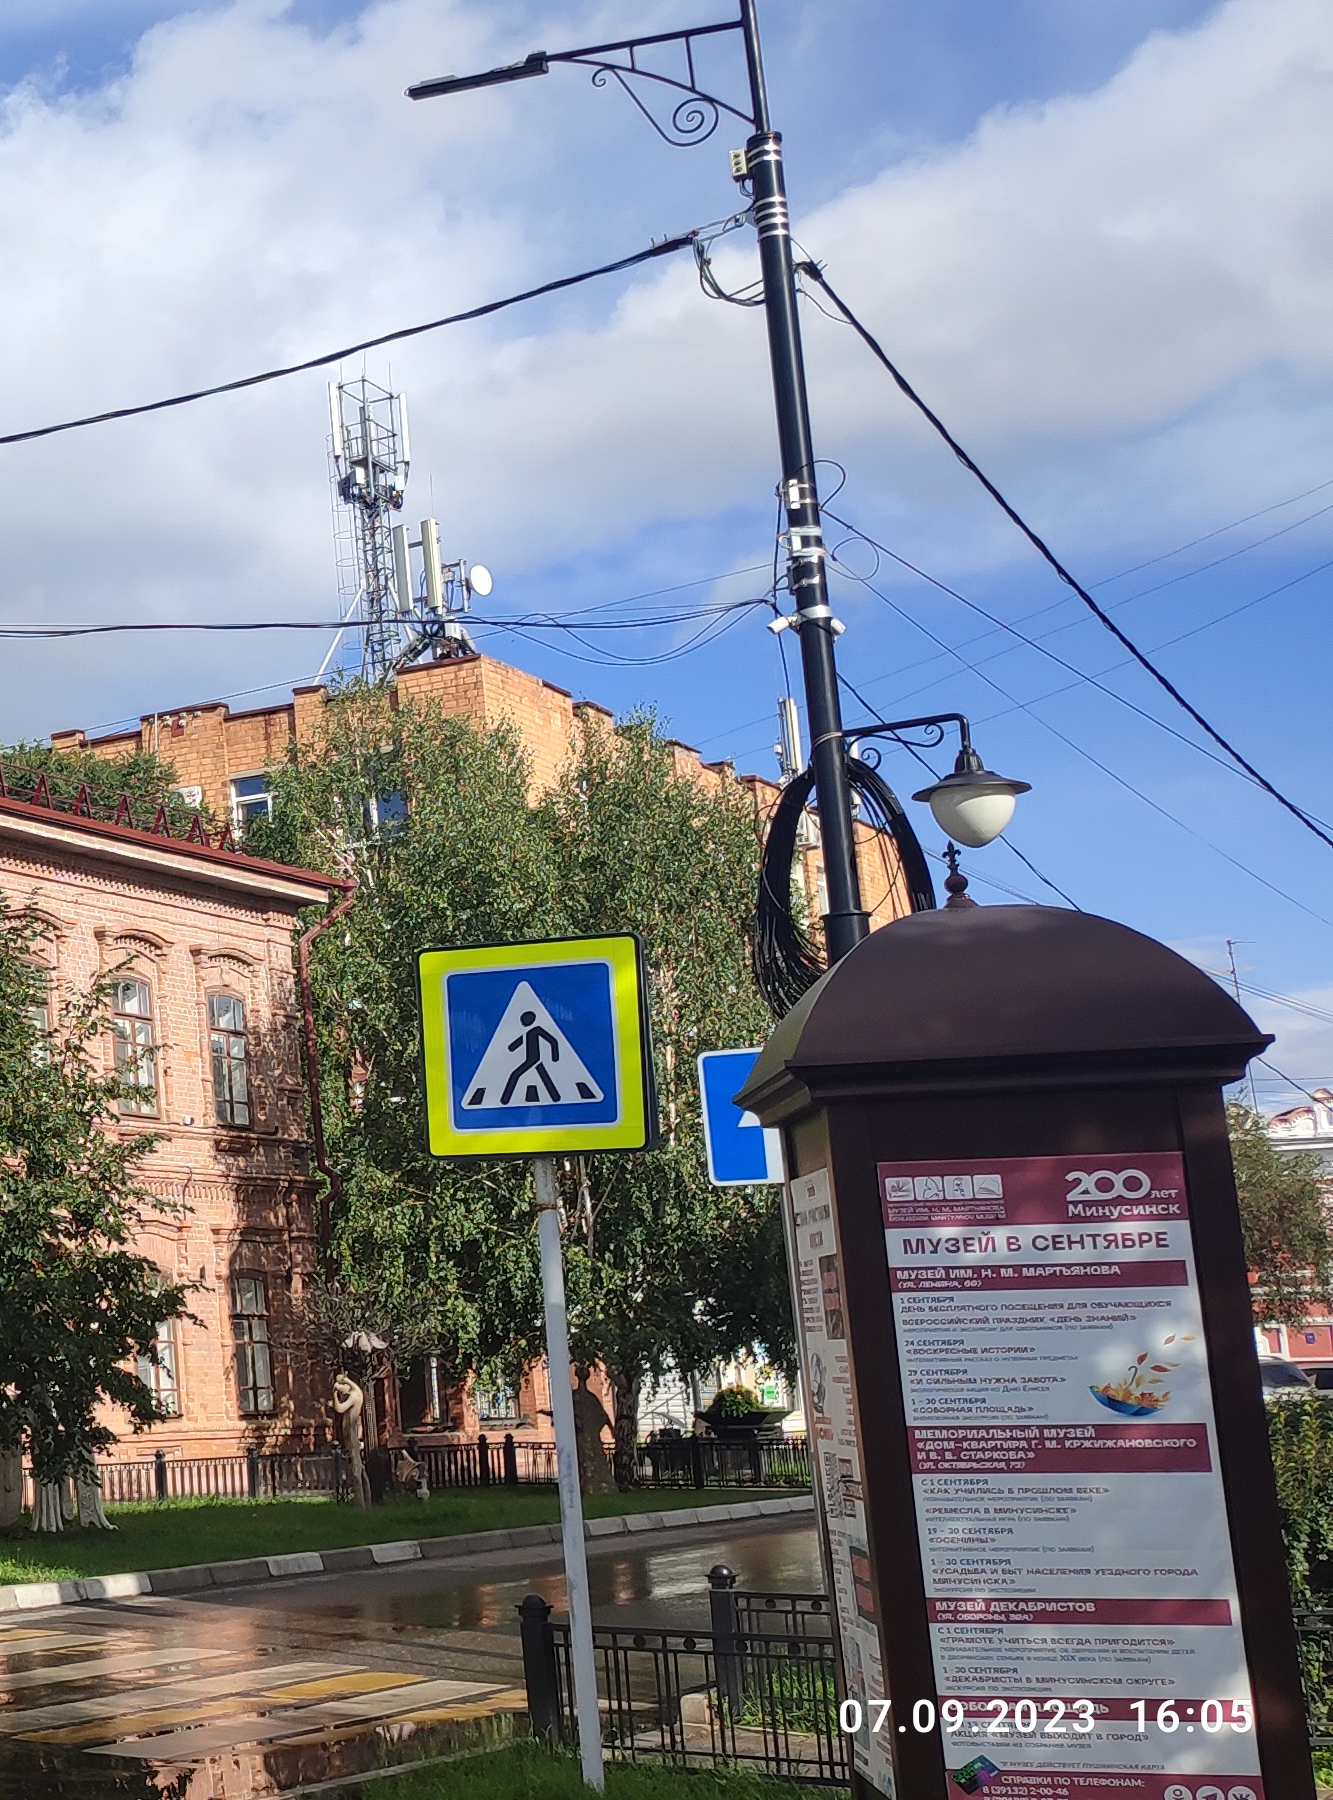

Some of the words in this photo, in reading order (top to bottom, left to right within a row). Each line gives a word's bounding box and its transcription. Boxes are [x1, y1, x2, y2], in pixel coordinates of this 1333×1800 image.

[1064, 1169, 1152, 1201] 200
[1150, 1189, 1179, 1199] лет
[1067, 1203, 1181, 1219] Минусинск
[902, 1230, 997, 1255] МУЗЕЙ
[1005, 1235, 1022, 1253] В
[1031, 1231, 1171, 1252] СЕНТЯБРЕ
[896, 1267, 946, 1280] МУЗЕЙ
[949, 1268, 978, 1279] ИМ.
[999, 1267, 1019, 1278] М.
[1021, 1264, 1122, 1277] МАРТЬЯНОВА
[907, 1296, 955, 1304] СЕНТЯБРЯ
[900, 1305, 926, 1313] ДЕНЬ
[928, 1304, 999, 1312] БЕСПЛАТНОГО
[1066, 1302, 1088, 1310] ДЛЯ
[1090, 1300, 1173, 1309] ОБУЧАЮЩИХСЯ
[902, 1316, 990, 1326] ВСЕРОССИЙСКИЙ
[992, 1315, 1046, 1325] ПРАЗДНИК
[916, 1339, 965, 1347] СЕНТЯБРЯ
[920, 1368, 969, 1377] СЕНТЯБРЯ
[979, 1376, 1018, 1385] НУЖНА
[938, 1397, 987, 1406] СЕНТЯБРЯ
[914, 1426, 1040, 1439] МЕМОРИАЛЬНЫЙ
[1043, 1425, 1096, 1438] МУЗЕЙ
[1031, 1440, 1042, 1449] Г.
[1064, 1438, 1197, 1449] КРЖИЖАНОВСКОГО
[916, 1451, 926, 1460] И
[936, 1478, 989, 1486] СЕНТЯБРЯ
[953, 1487, 1006, 1495] УЧИЛИСЬ
[961, 1527, 1014, 1535] СЕНТЯБРЯ
[959, 1558, 1012, 1566] СЕНТЯБРЯ
[1026, 1568, 1091, 1576] НАСЕЛЕНИЯ
[1094, 1568, 1151, 1576] УЕЗДНОГО
[1153, 1568, 1199, 1577] ГОРОДА
[935, 1599, 986, 1611] МУЗЕЙ
[989, 1600, 1097, 1612] ДЕКАБРИСТОВ
[937, 1627, 945, 1635] С
[953, 1627, 1004, 1635] СЕНТЯБРЯ
[939, 1636, 995, 1645] «ГРАМОТЕ
[997, 1636, 1048, 1645] УЧИТЬСЯ
[1050, 1637, 1092, 1646] ВСЕГДА
[1094, 1637, 1175, 1646] ПРИГОДИТСЯ»
[967, 1666, 1018, 1675] СЕНТЯБРЯ
[943, 1675, 1023, 1684] «ДЕКАБРИСТЫ
[950, 1731, 988, 1739] АКЦИЯ
[1039, 1732, 1093, 1742] ВЫХОДИТ
[1001, 1775, 1053, 1785] СПРАВКИ
[1054, 1776, 1071, 1785] ПО
[1071, 1777, 1147, 1788] ТЕЛЕФОНАМ:
[982, 1785, 990, 1794] 8
